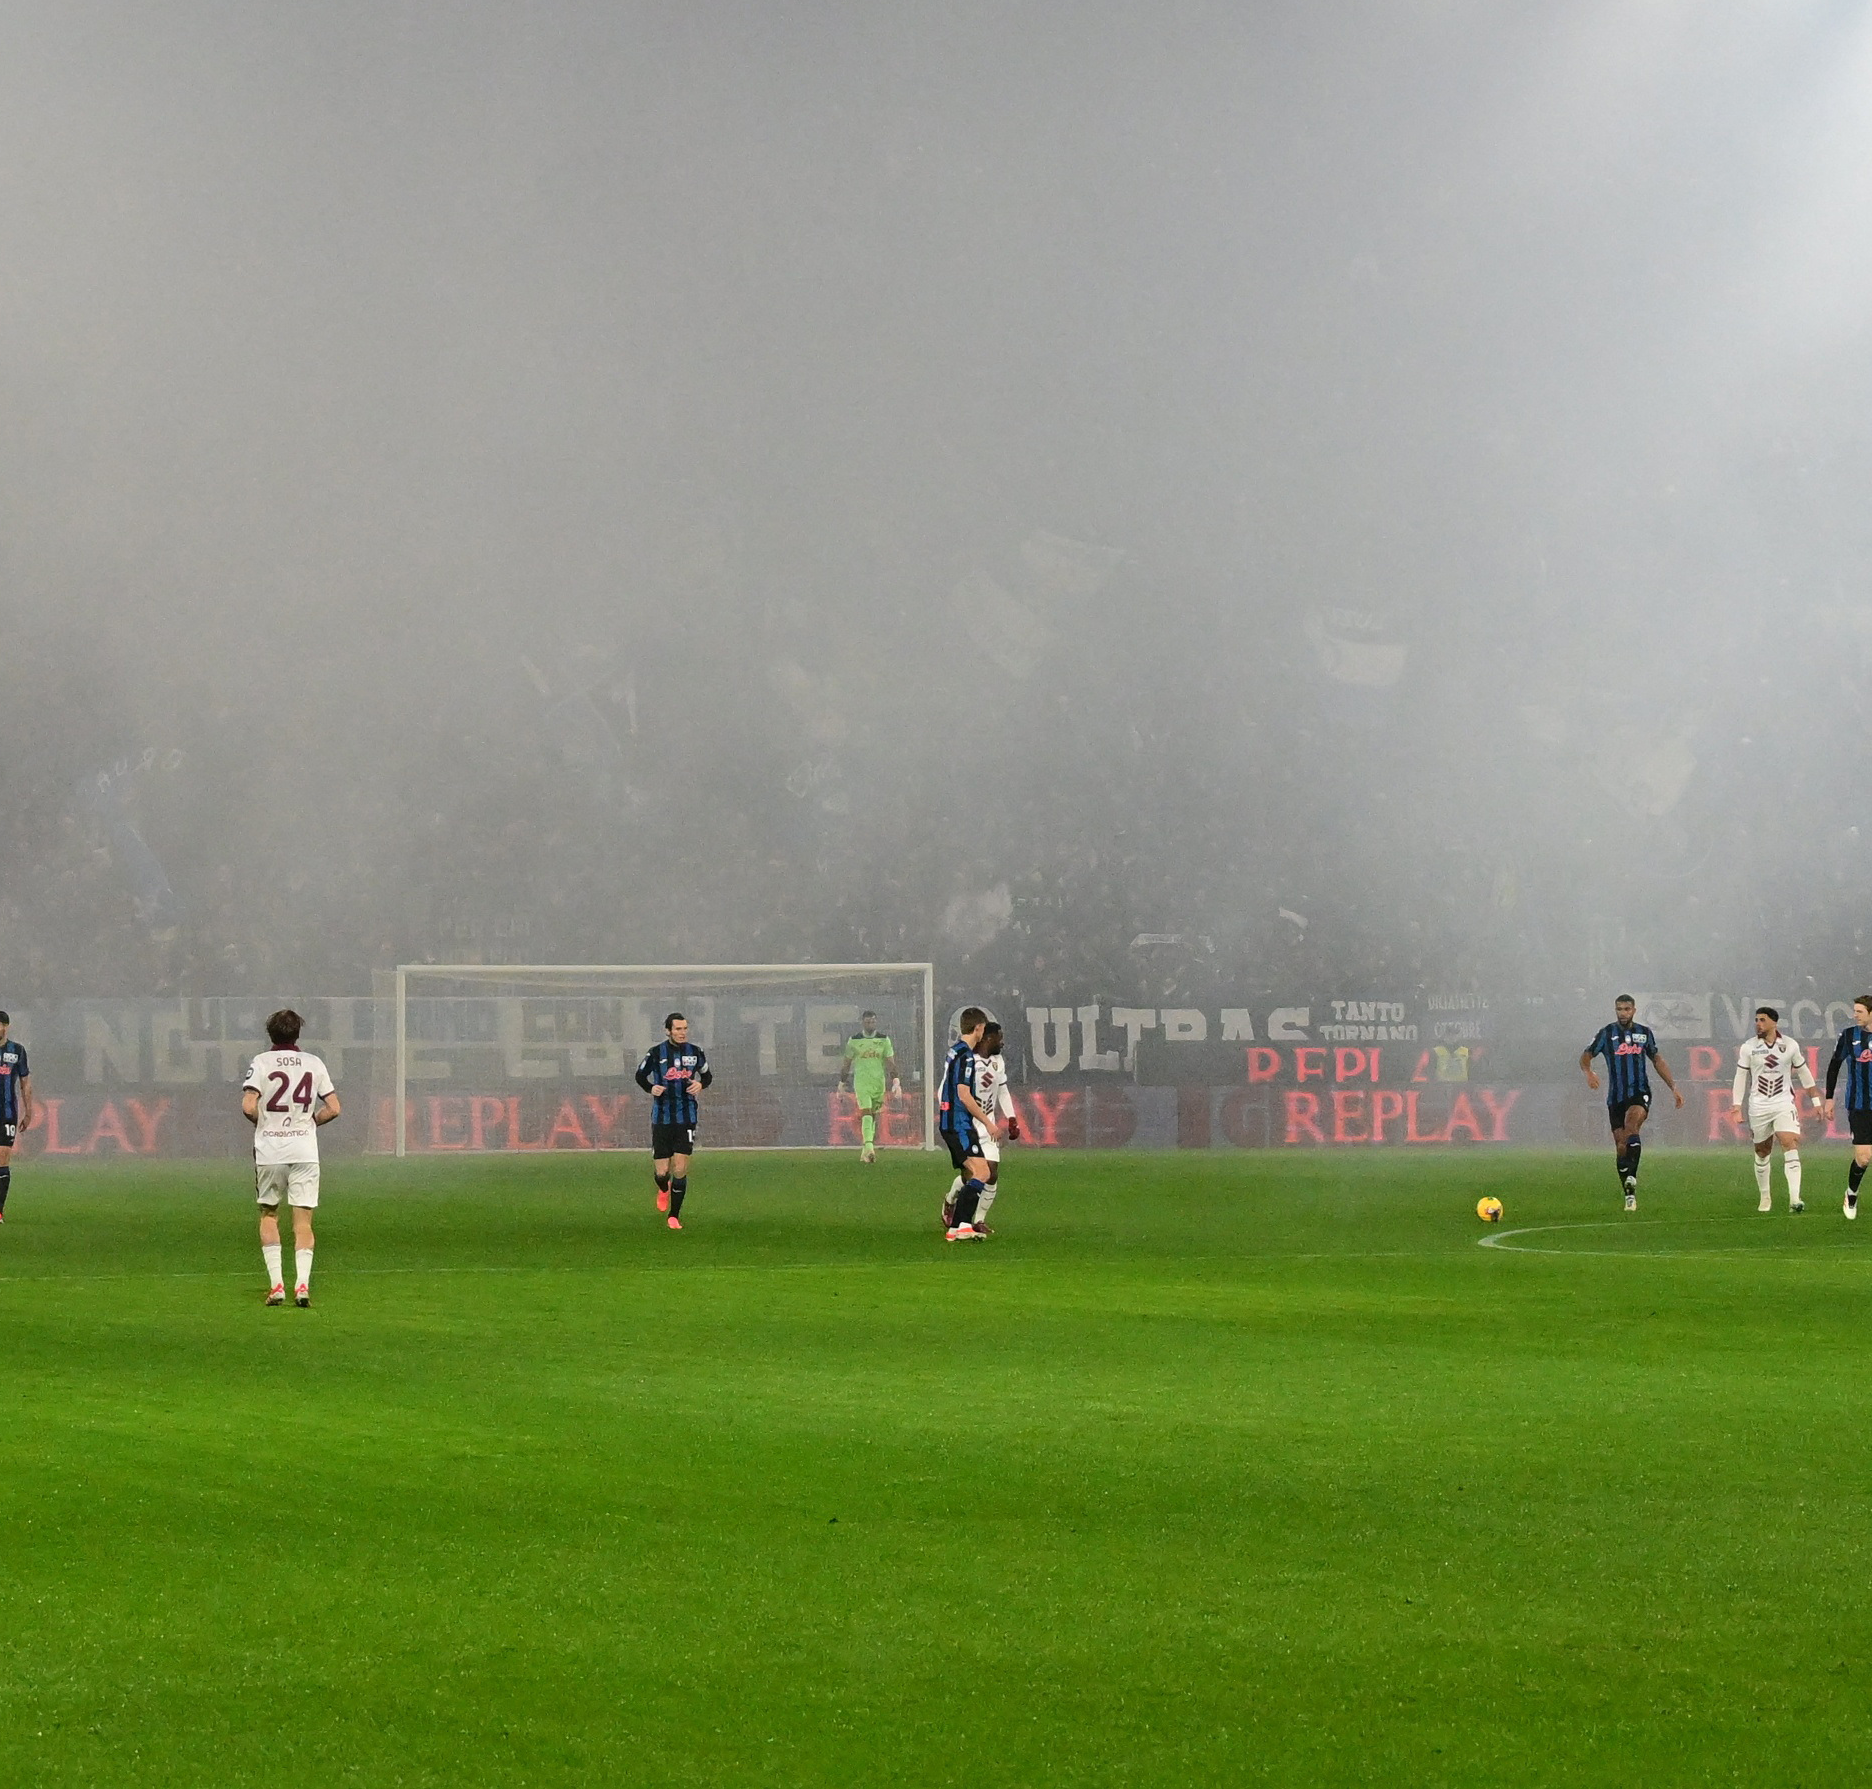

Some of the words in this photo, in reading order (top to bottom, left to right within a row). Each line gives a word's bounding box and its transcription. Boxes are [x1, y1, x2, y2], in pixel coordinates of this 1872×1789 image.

[1331, 1000, 1405, 1023] TANTO
[1319, 1024, 1418, 1041] TORNANO
[276, 1056, 302, 1067] SOSA
[266, 1071, 313, 1113] 24
[1282, 1088, 1521, 1145] REPLAY
[4, 1123, 16, 1137] 19
